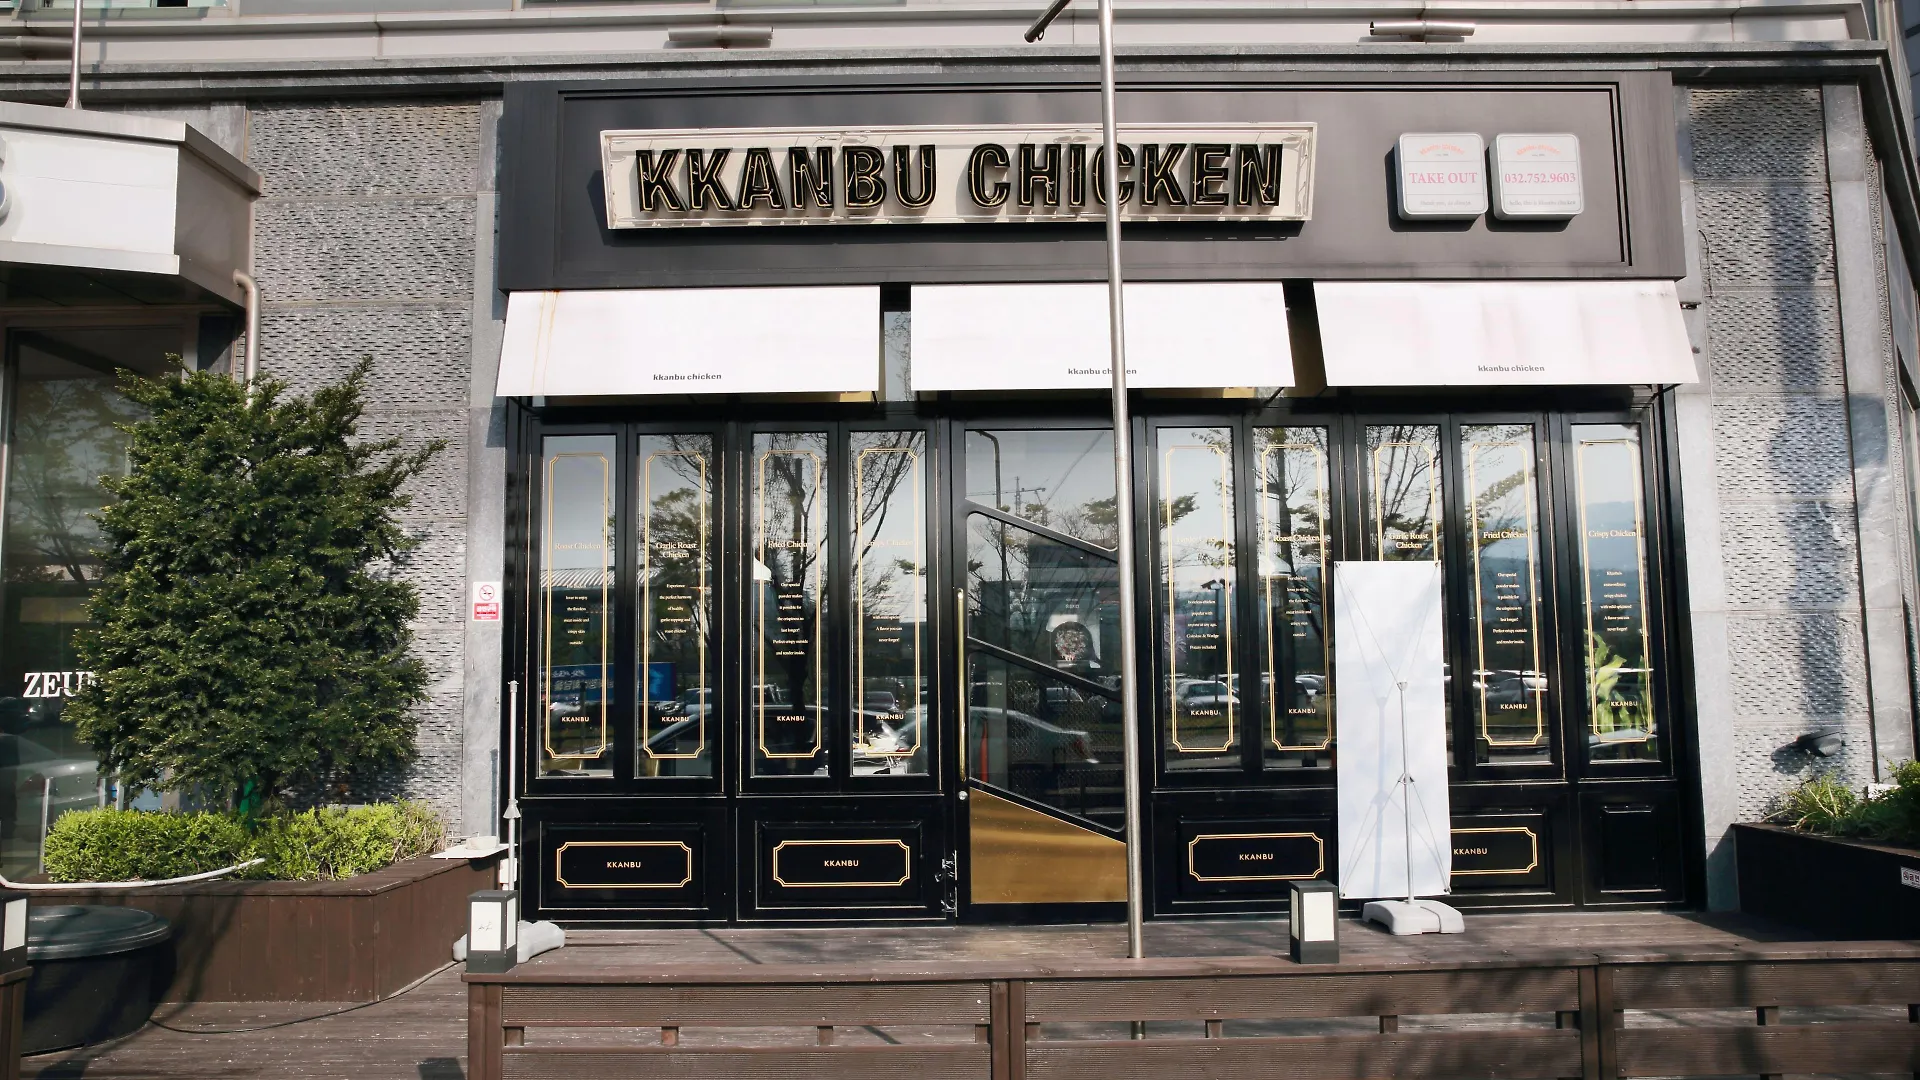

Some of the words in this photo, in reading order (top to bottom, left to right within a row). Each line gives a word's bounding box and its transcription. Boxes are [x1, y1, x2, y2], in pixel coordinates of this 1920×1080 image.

[635, 144, 938, 213] KKANBU
[966, 142, 1282, 209] CHICKEN
[1409, 172, 1444, 184] TAKE
[1447, 172, 1477, 183] OUT
[1504, 172, 1576, 184] 032.752.9603
[1068, 367, 1100, 375] kkanbu
[1102, 367, 1137, 375] chen
[1511, 364, 1545, 372] chicken
[1389, 532, 1409, 540] Garlic
[1410, 532, 1429, 540] Roast
[1483, 531, 1501, 539] Fried
[1588, 530, 1609, 539] Crispy
[1610, 529, 1637, 538] Chicken
[656, 541, 676, 550] Garlic
[677, 541, 697, 549] Roast
[768, 540, 785, 548] Fried
[1396, 541, 1423, 549] Chicken
[662, 550, 690, 558] Chicken
[1453, 847, 1488, 855] KKANBU
[1238, 853, 1274, 861] KKANBU
[824, 859, 860, 867] KKANBU
